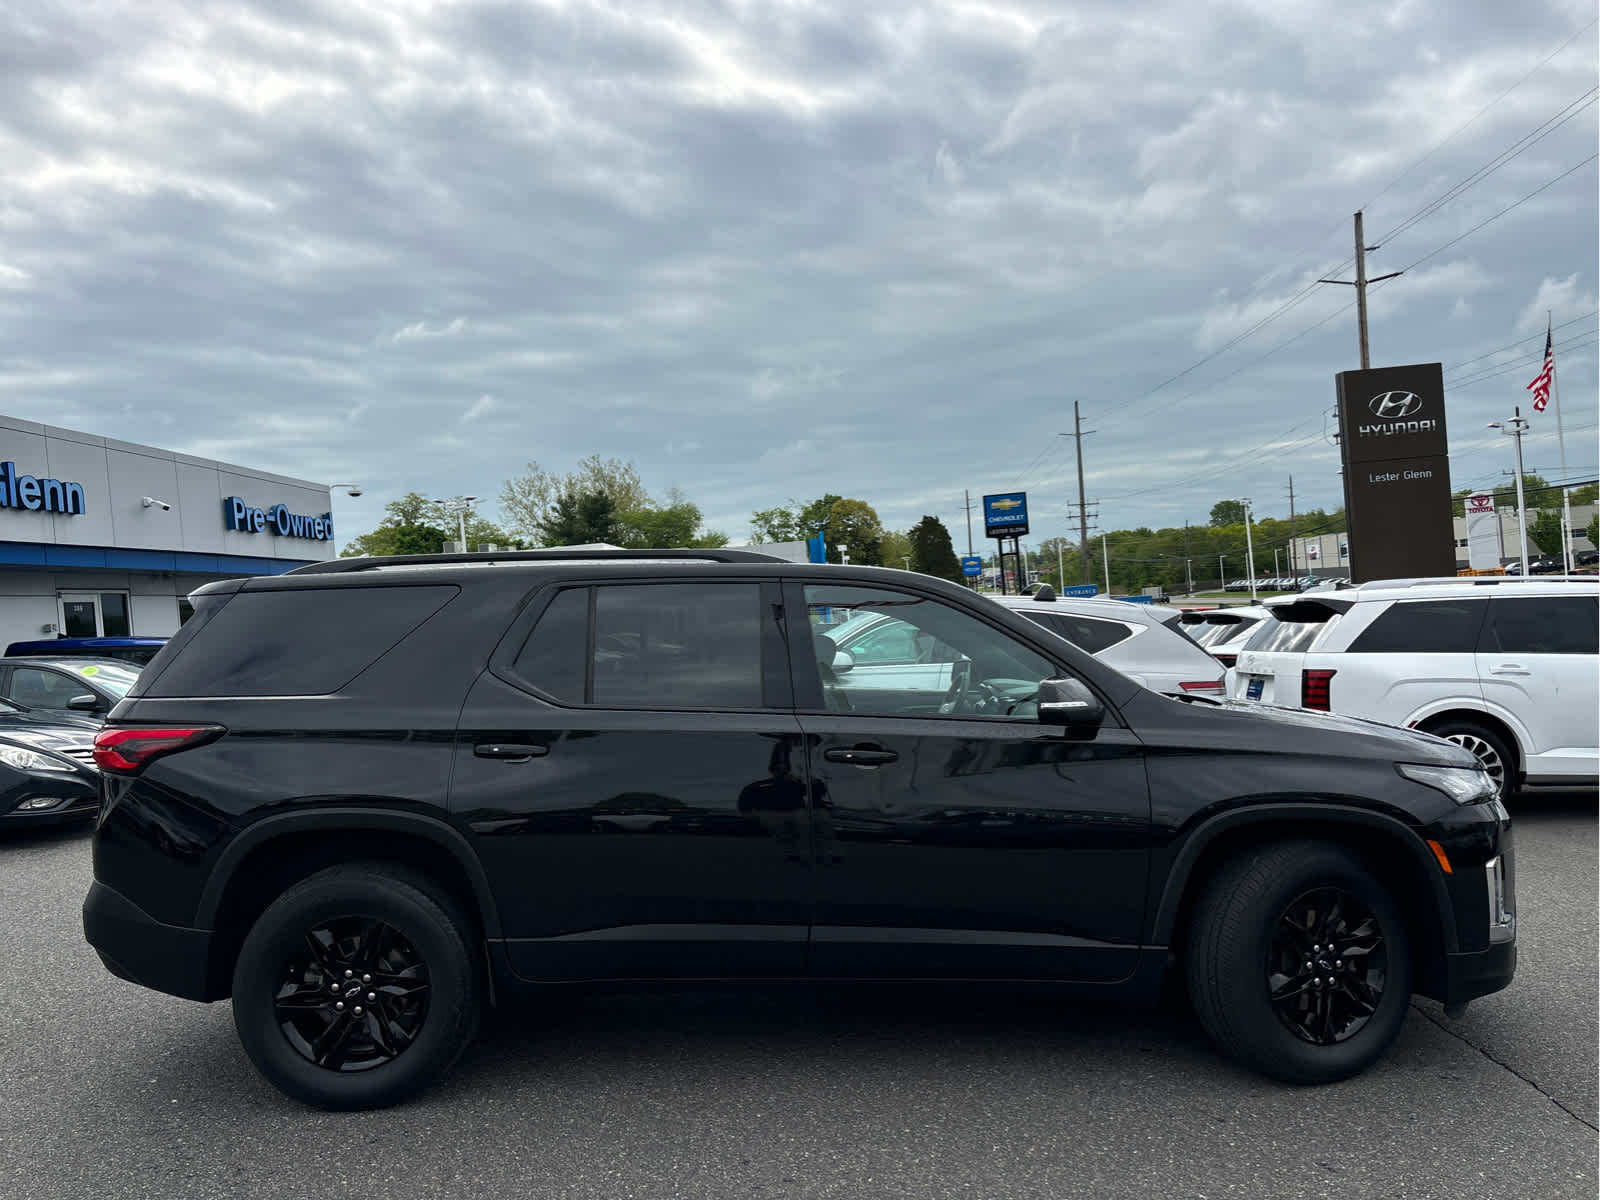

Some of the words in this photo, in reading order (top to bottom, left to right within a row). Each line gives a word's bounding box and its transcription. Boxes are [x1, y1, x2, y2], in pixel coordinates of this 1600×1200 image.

[1359, 419, 1436, 437] HYUNDAI
[1369, 473, 1400, 483] Lester
[1403, 470, 1432, 480] Glenn
[225, 496, 334, 540] Pre-Owned
[988, 514, 1025, 523] CHEVROLET
